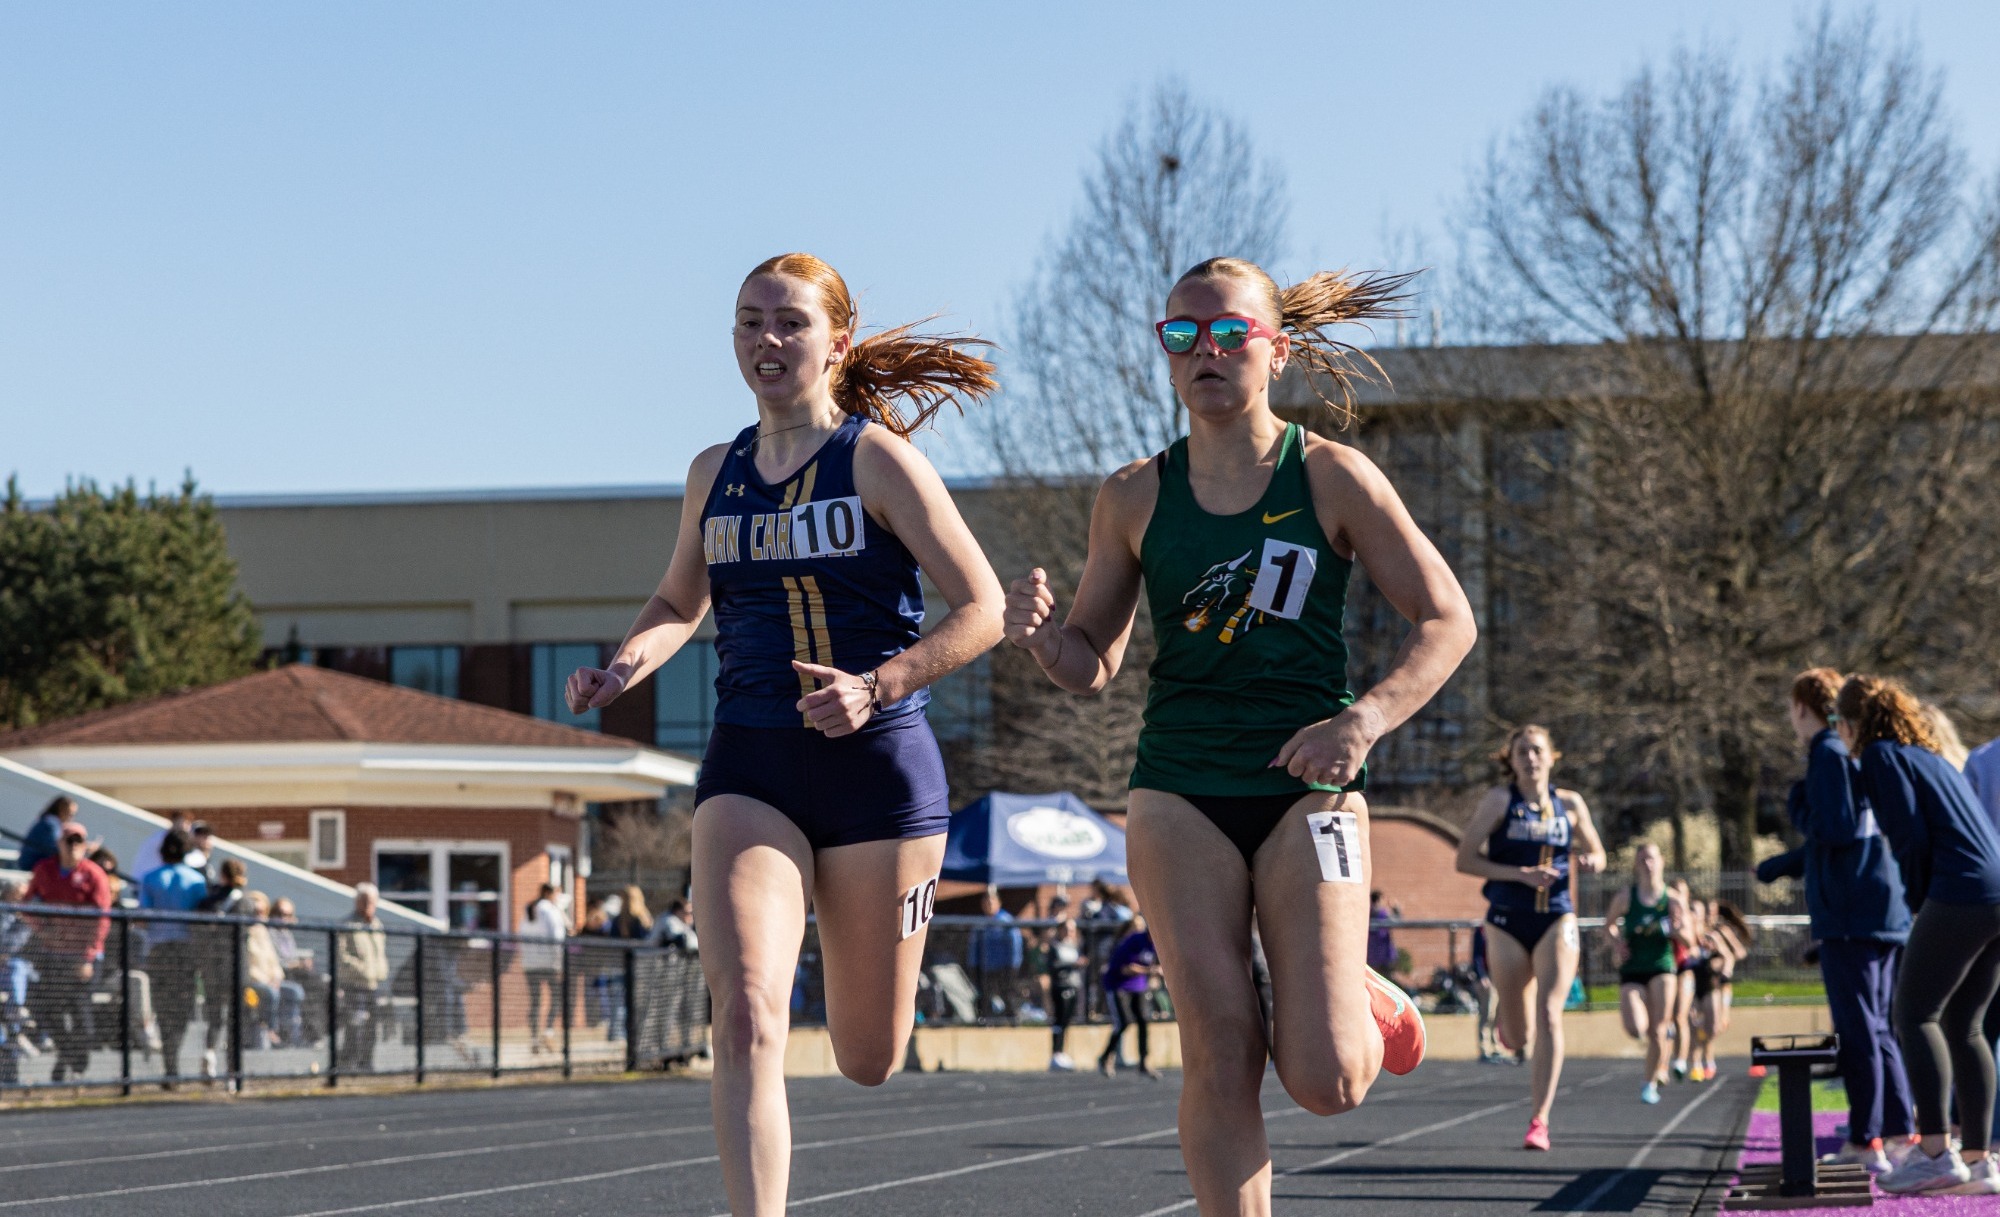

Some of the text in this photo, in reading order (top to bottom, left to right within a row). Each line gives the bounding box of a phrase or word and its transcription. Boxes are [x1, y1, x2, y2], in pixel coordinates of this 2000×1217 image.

[704, 515, 742, 565] OHN
[798, 500, 855, 553] 10
[1270, 549, 1300, 613] 1
[1319, 816, 1351, 877] 1
[907, 879, 936, 932] 10
